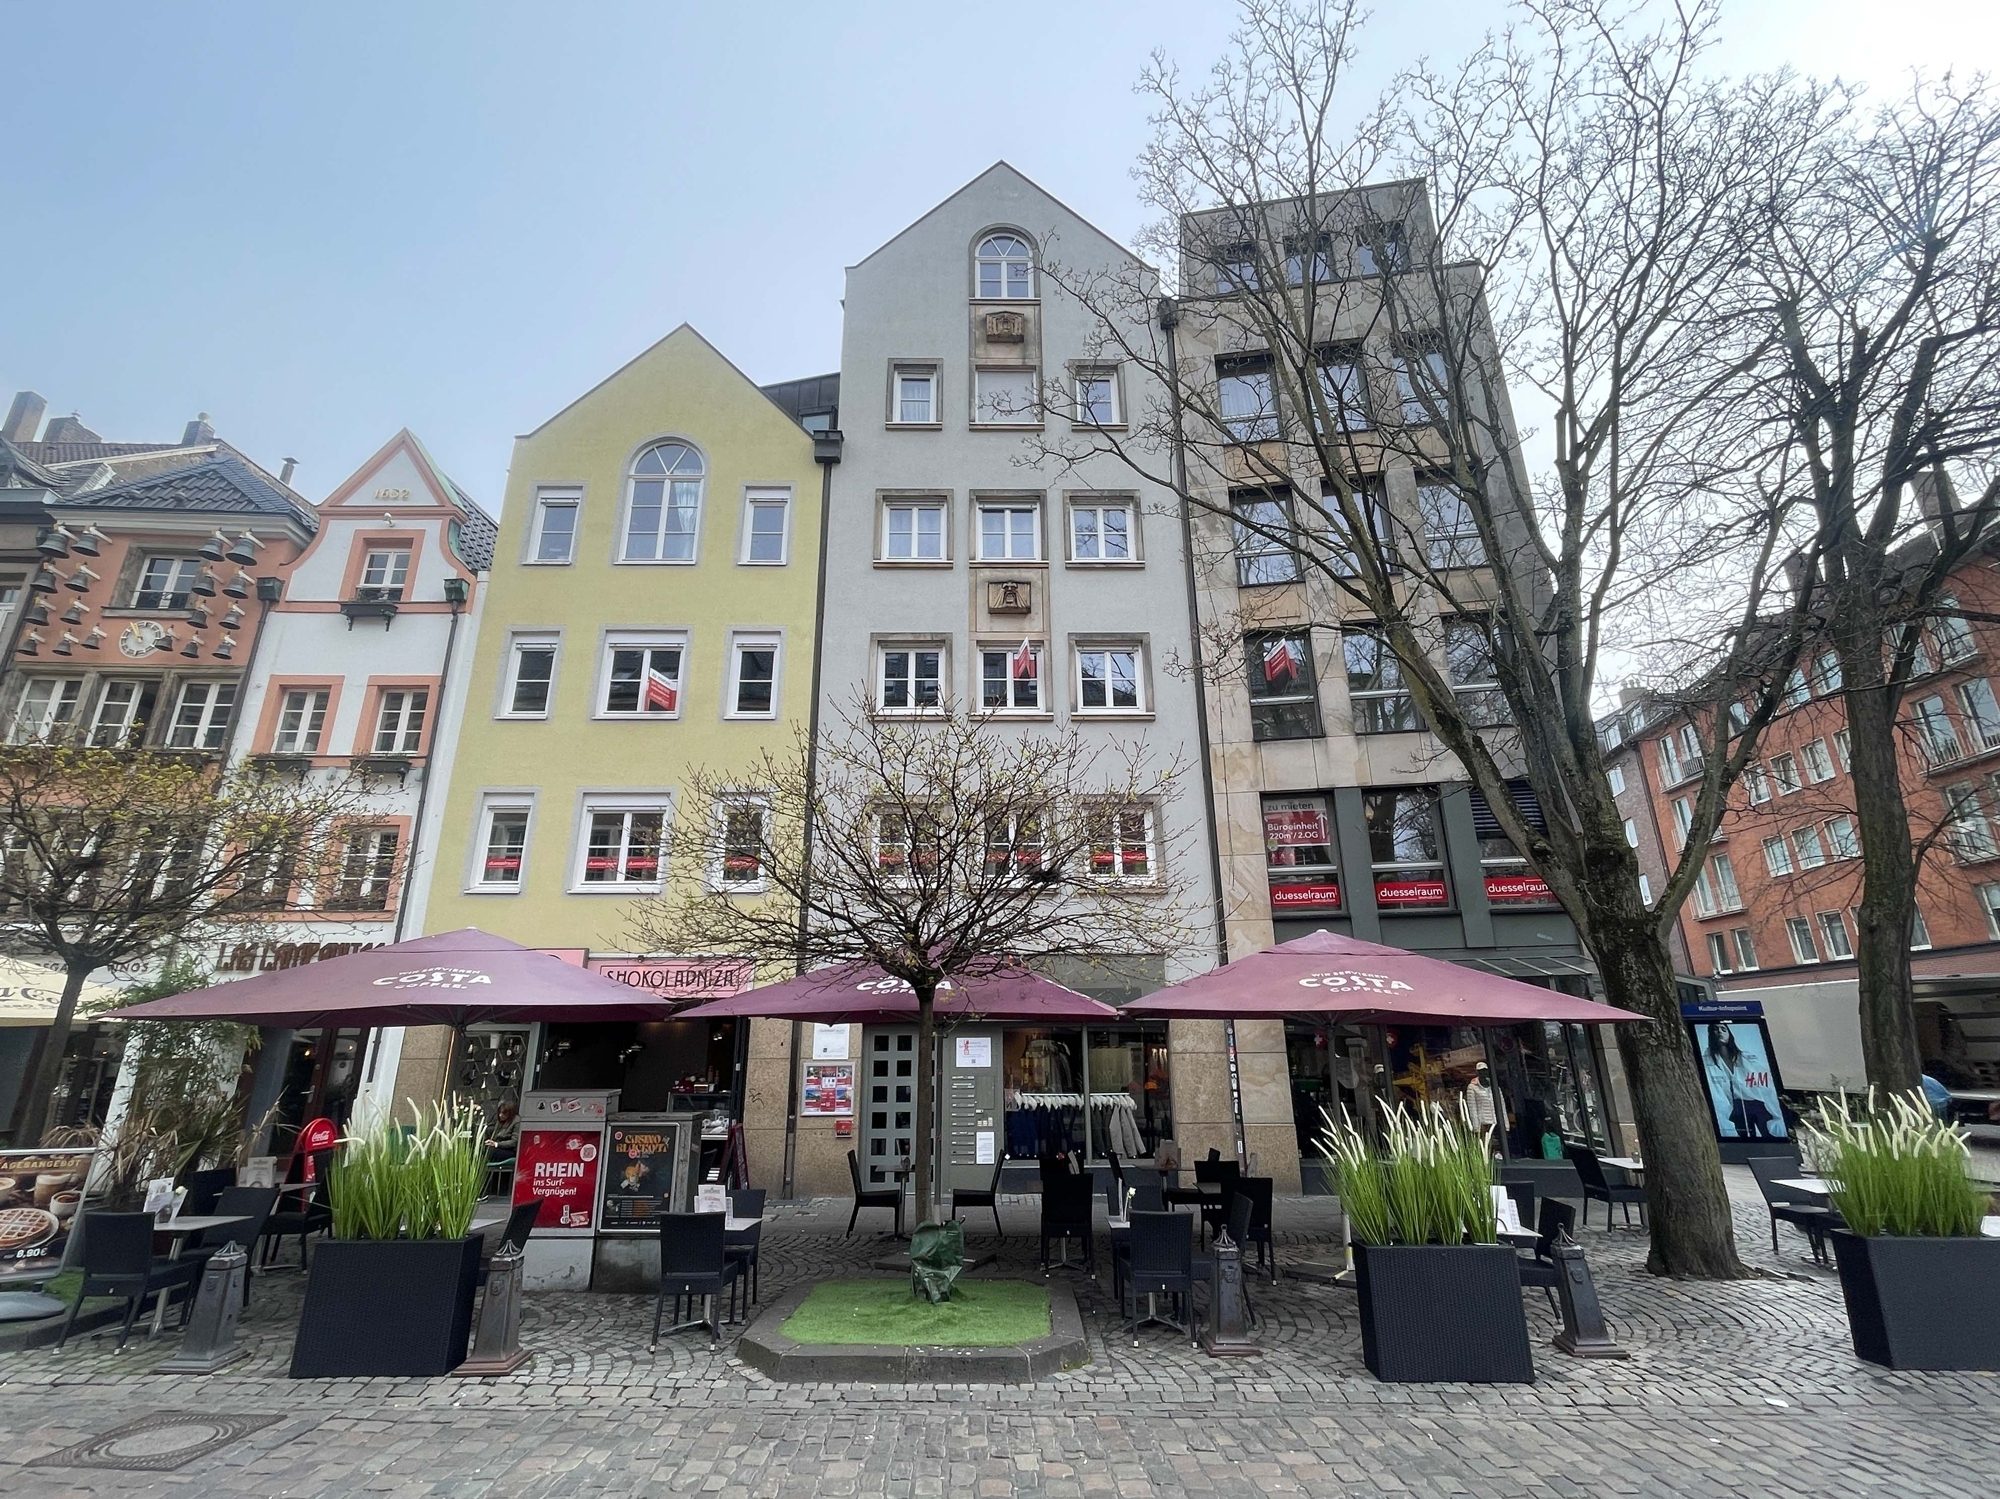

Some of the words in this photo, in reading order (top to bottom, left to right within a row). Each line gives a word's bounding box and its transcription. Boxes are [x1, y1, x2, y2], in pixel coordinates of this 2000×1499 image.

[1281, 801, 1314, 810] mieten
[1267, 822, 1319, 831] Büroeinheit
[1298, 831, 1319, 839] 2.OG
[1275, 890, 1336, 900] duesselraum
[1380, 887, 1443, 898] duesselraum
[372, 971, 492, 986] COSTA
[1298, 975, 1415, 991] COSTA
[394, 981, 463, 989] COFFEE
[1329, 986, 1393, 994] COFFEE
[1744, 1072, 1769, 1088] H&M
[0, 1160, 81, 1169] AGESANGEBOT
[534, 1162, 585, 1177] RHEIN
[533, 1178, 545, 1186] ins
[546, 1178, 565, 1186] Surf-
[532, 1187, 577, 1197] Vergnügen!
